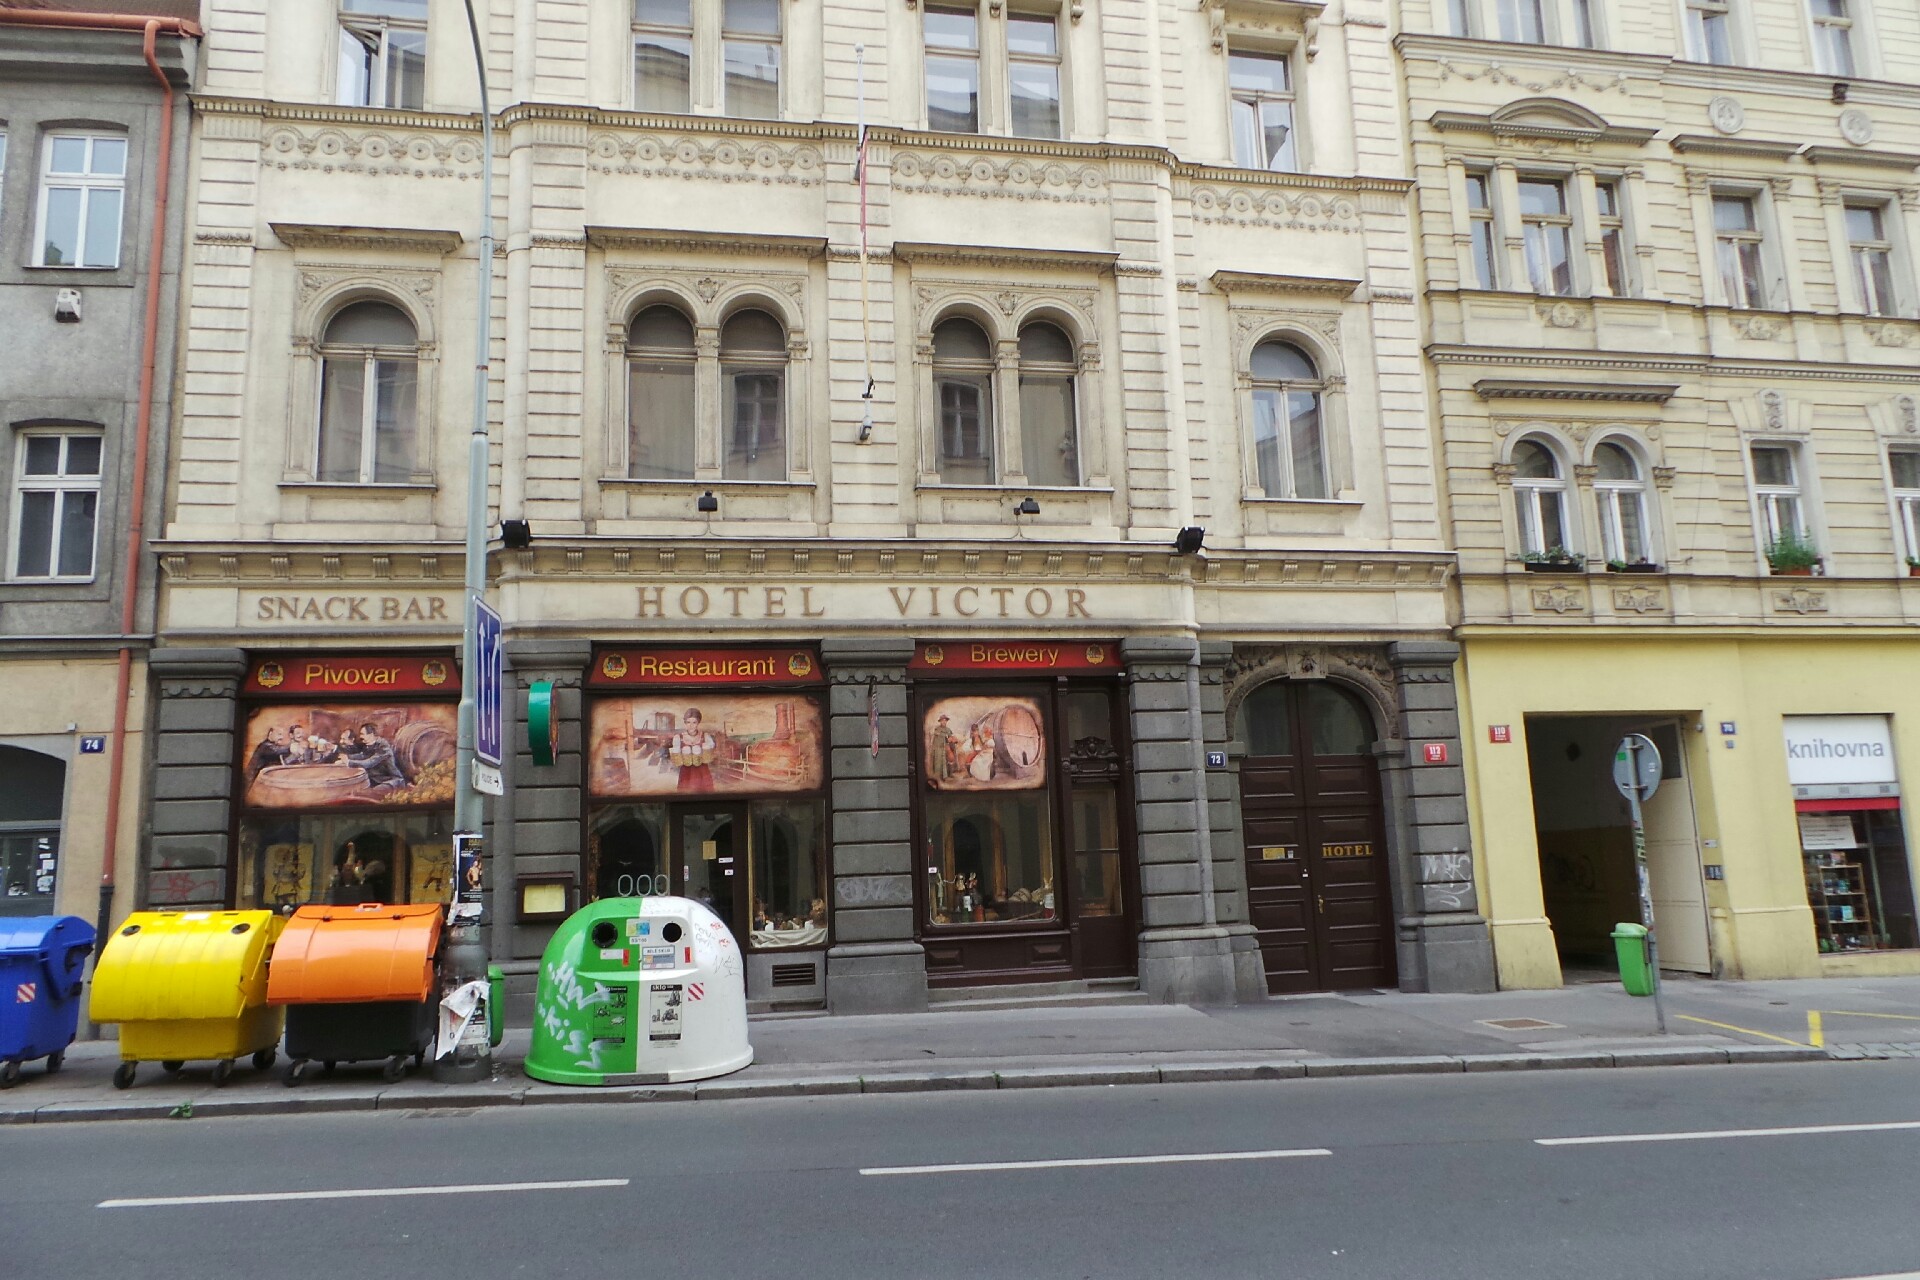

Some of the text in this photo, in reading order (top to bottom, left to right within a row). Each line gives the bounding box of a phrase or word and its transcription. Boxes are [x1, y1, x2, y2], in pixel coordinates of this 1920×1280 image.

[257, 596, 448, 621] SNACK BAR
[635, 586, 1092, 618] HOTEL VICTOR
[971, 644, 1059, 665] Brewery
[305, 663, 400, 685] Pivovar
[640, 656, 776, 677] Restaurant
[85, 740, 99, 750] 74
[1429, 745, 1441, 755] 112
[1787, 739, 1885, 758] knihovna
[1210, 755, 1221, 764] 72
[1322, 845, 1374, 857] HOTEL
